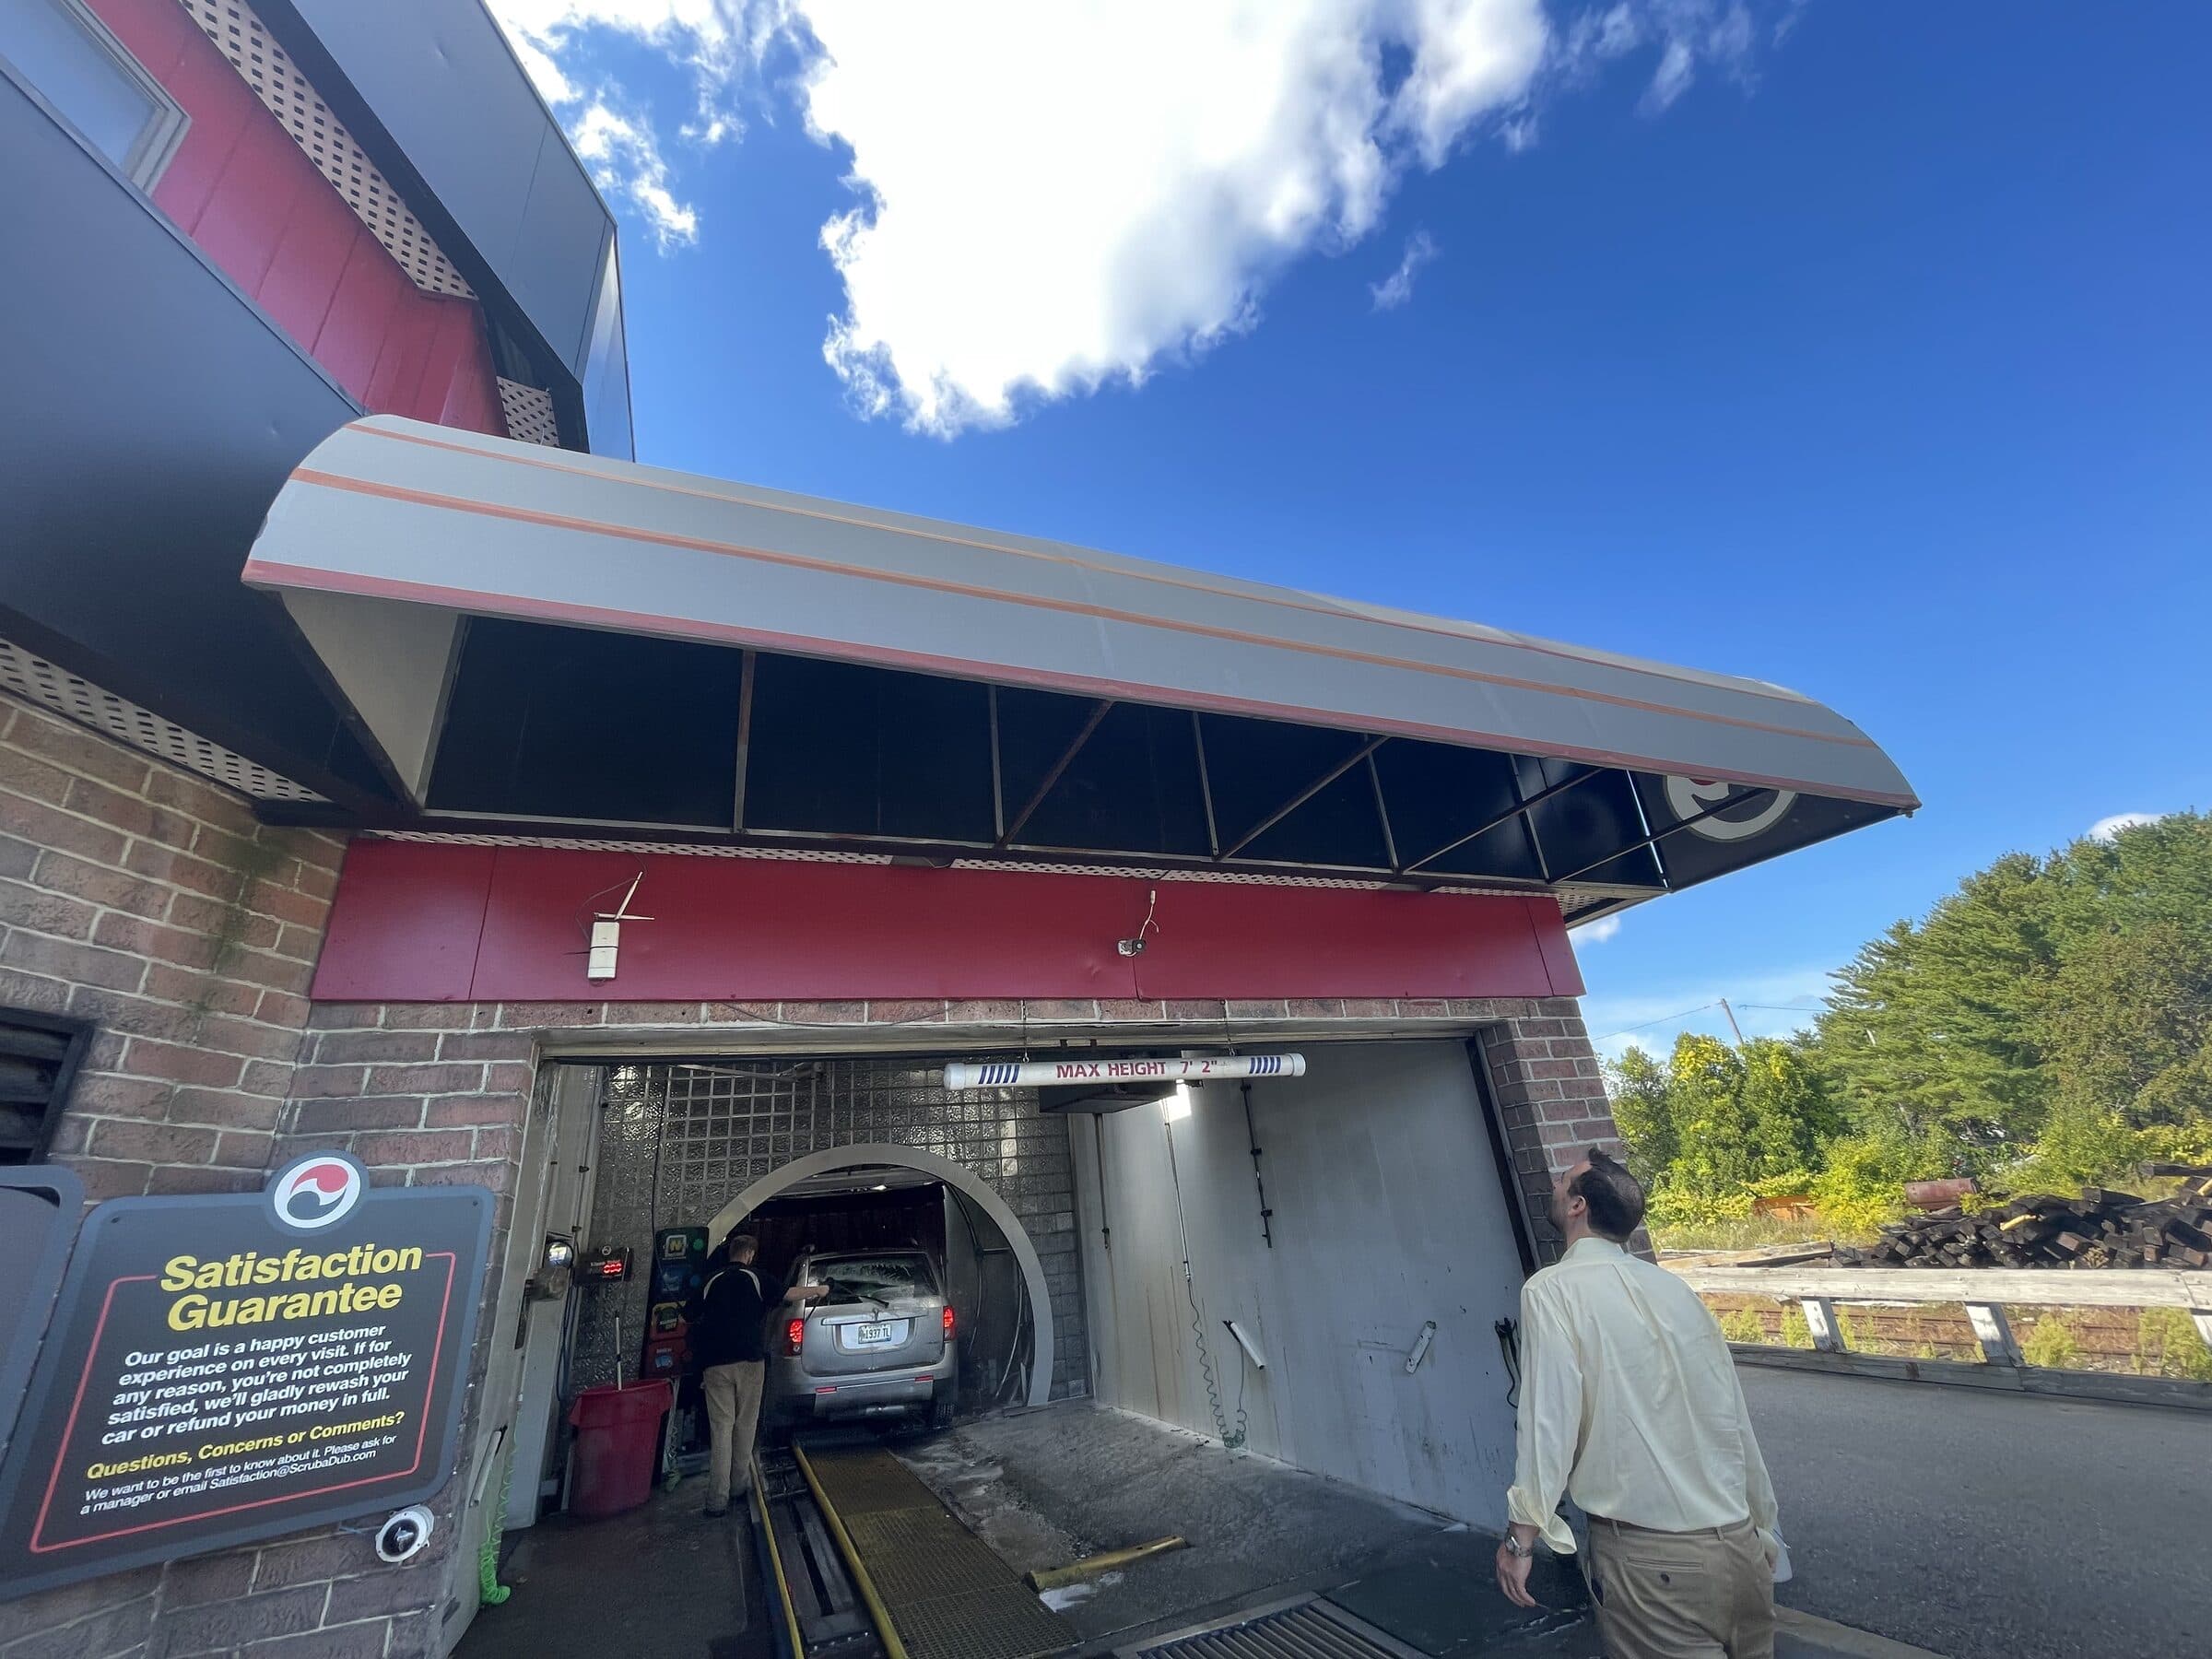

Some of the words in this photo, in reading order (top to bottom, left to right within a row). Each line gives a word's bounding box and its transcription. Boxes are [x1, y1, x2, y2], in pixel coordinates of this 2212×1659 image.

[1056, 1064, 1100, 1078] MAX
[1107, 1061, 1166, 1077] HEIGHT
[160, 1243, 422, 1291] Satisfaction
[168, 1282, 403, 1331] Guarantee
[119, 1365, 227, 1386] experience
[230, 1359, 254, 1371] on
[258, 1352, 308, 1369] every
[312, 1345, 348, 1360] visit.
[353, 1341, 367, 1355] If
[369, 1339, 392, 1354] for
[125, 1351, 164, 1367] Our
[167, 1344, 210, 1365] goal
[214, 1343, 229, 1356] is
[234, 1342, 246, 1354] a
[250, 1335, 305, 1352] happy
[308, 1325, 386, 1344] customer
[108, 1399, 198, 1425] satisfied,
[205, 1392, 247, 1411] we'll
[250, 1384, 305, 1406] gladly
[308, 1373, 369, 1395] rewash
[372, 1370, 409, 1388] your
[112, 1390, 152, 1406] any
[155, 1380, 227, 1400] reason,
[231, 1371, 288, 1392] you're
[291, 1364, 321, 1381] not
[323, 1352, 412, 1376] completely
[101, 1430, 137, 1445] car
[140, 1426, 164, 1439] or
[167, 1412, 232, 1434] refund
[234, 1406, 277, 1427] your
[280, 1396, 339, 1417] money
[342, 1394, 358, 1406] in
[361, 1387, 391, 1404] full.
[85, 1488, 108, 1501] We
[112, 1481, 145, 1496] want
[147, 1478, 159, 1489] to
[162, 1476, 179, 1487] be
[182, 1470, 202, 1483] the
[204, 1465, 228, 1480] first
[229, 1464, 241, 1475] to
[243, 1458, 276, 1470] know
[277, 1450, 310, 1465] about
[312, 1448, 321, 1459] it.
[324, 1441, 359, 1456] Please
[361, 1438, 380, 1450] ask
[382, 1434, 397, 1446] for
[87, 1451, 193, 1479] Questions,
[198, 1435, 283, 1460] Concerns
[287, 1430, 307, 1444] or
[309, 1411, 406, 1440] Comments?
[79, 1504, 90, 1515] a
[93, 1492, 155, 1512] manager
[157, 1488, 171, 1500] or
[172, 1481, 207, 1497] email
[209, 1449, 376, 1489] Satisfaction@ScrubaDub.com
